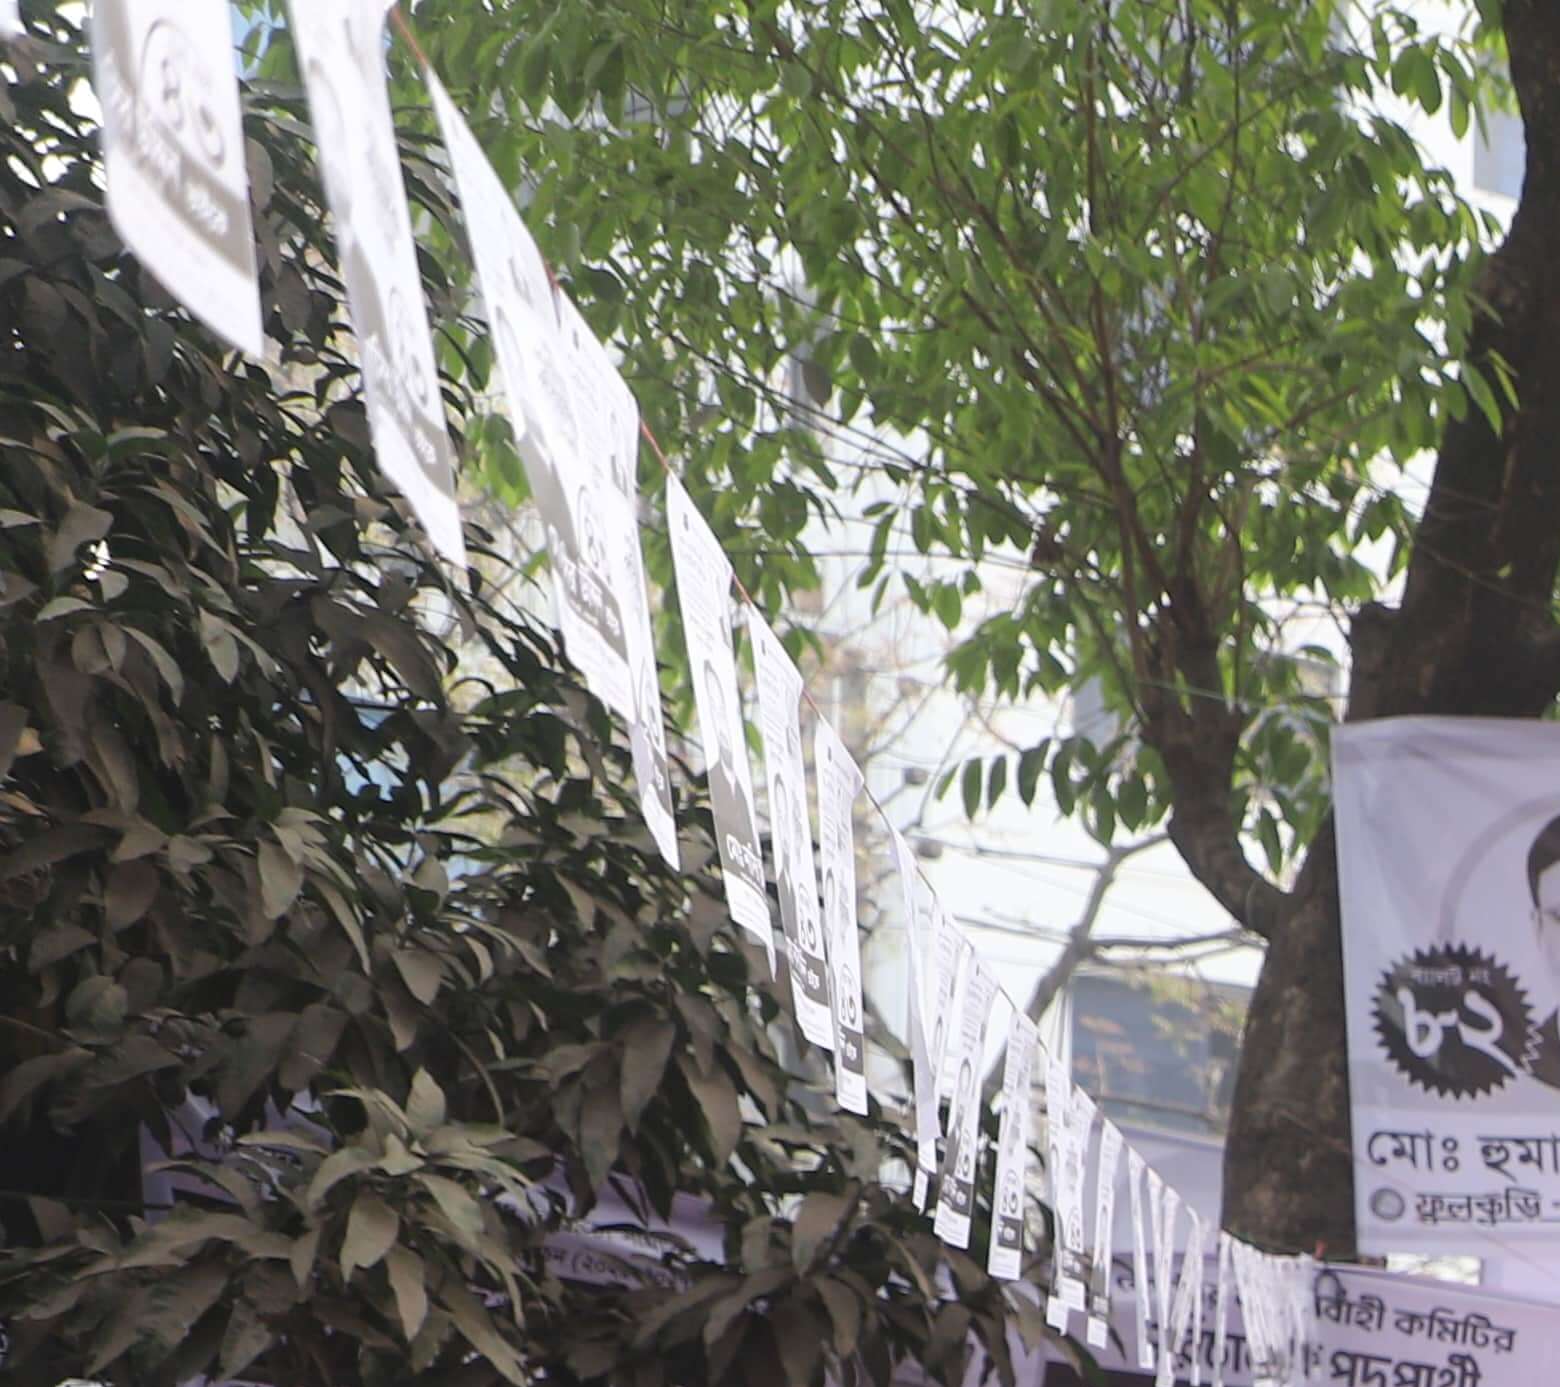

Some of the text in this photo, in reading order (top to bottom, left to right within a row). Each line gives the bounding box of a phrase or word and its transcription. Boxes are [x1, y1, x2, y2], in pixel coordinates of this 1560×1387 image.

[1397, 988, 1518, 1078] ৮২
[1368, 1130, 1460, 1173] মোঃ
[1394, 1307, 1516, 1354] কমিটির
